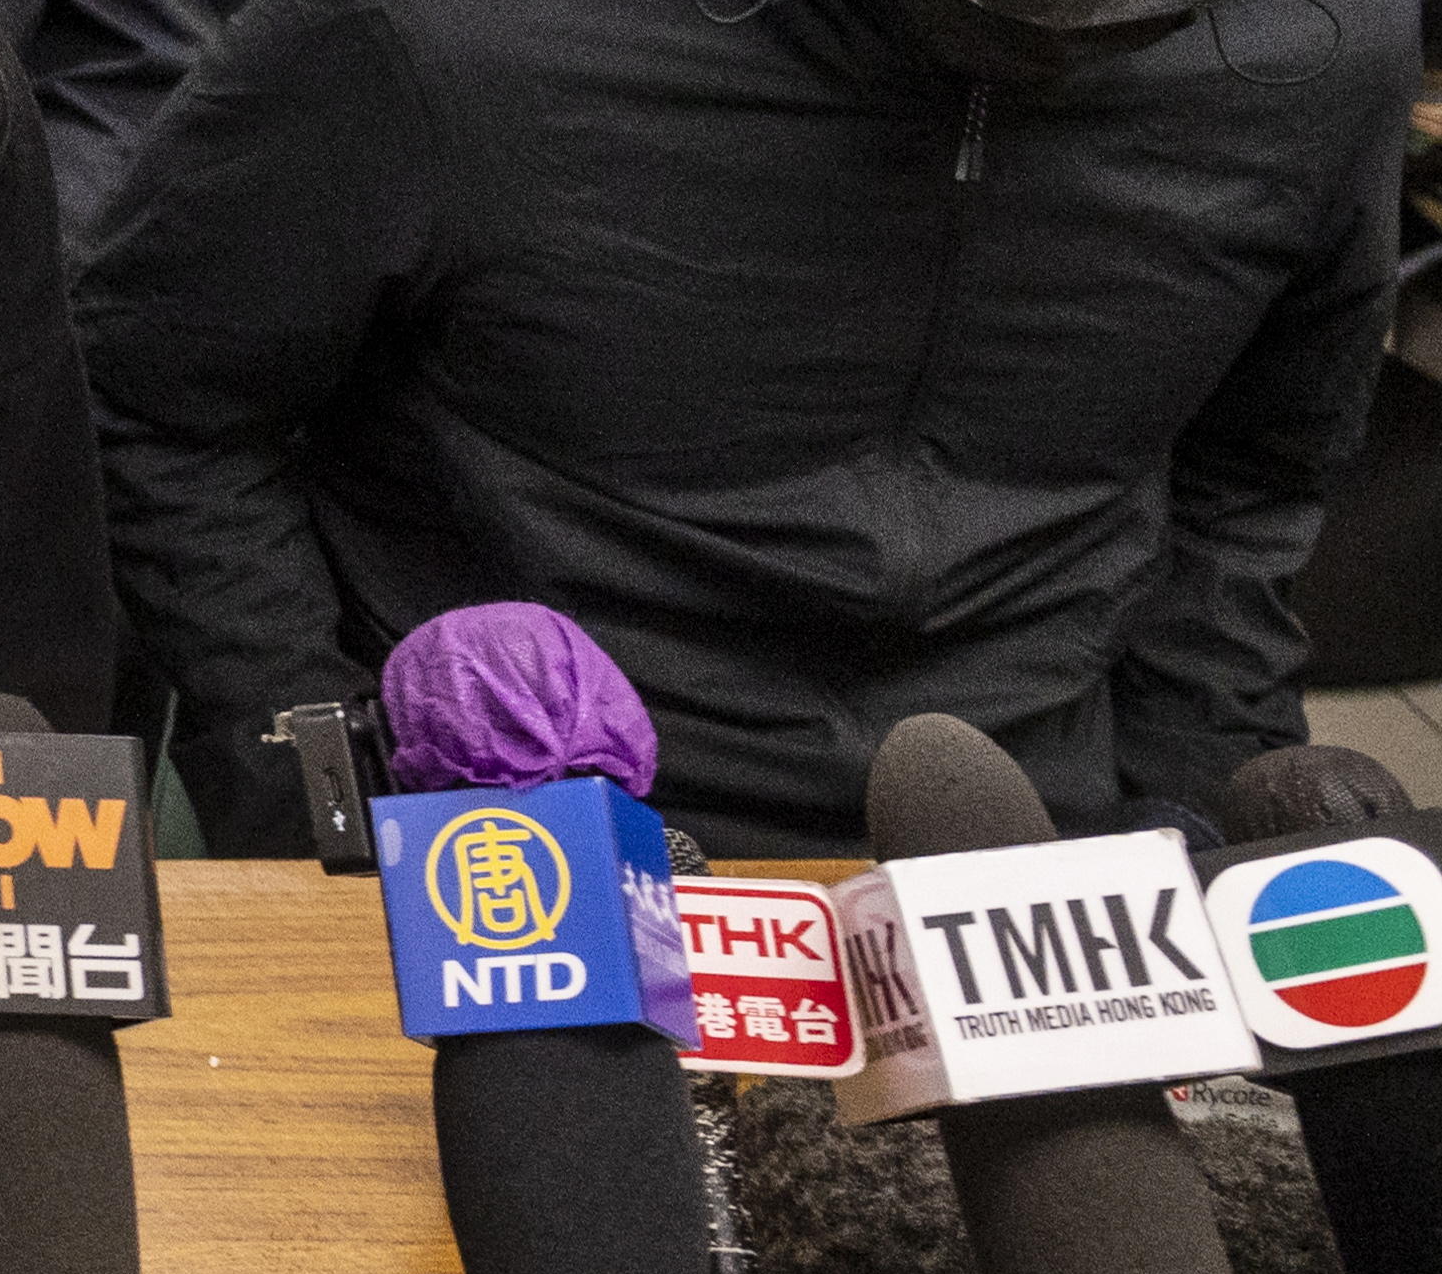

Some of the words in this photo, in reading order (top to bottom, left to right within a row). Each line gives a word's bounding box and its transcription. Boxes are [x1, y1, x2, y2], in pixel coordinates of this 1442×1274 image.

[679, 913, 824, 961] THK
[922, 887, 1207, 1005] TMHK
[442, 951, 588, 1008] NTD
[954, 1011, 1024, 1040] TRUTH
[1026, 1003, 1094, 1032] MEDIA
[1093, 995, 1157, 1024] HONG
[1157, 988, 1218, 1018] KONG
[1192, 1081, 1271, 1107] Rycote
